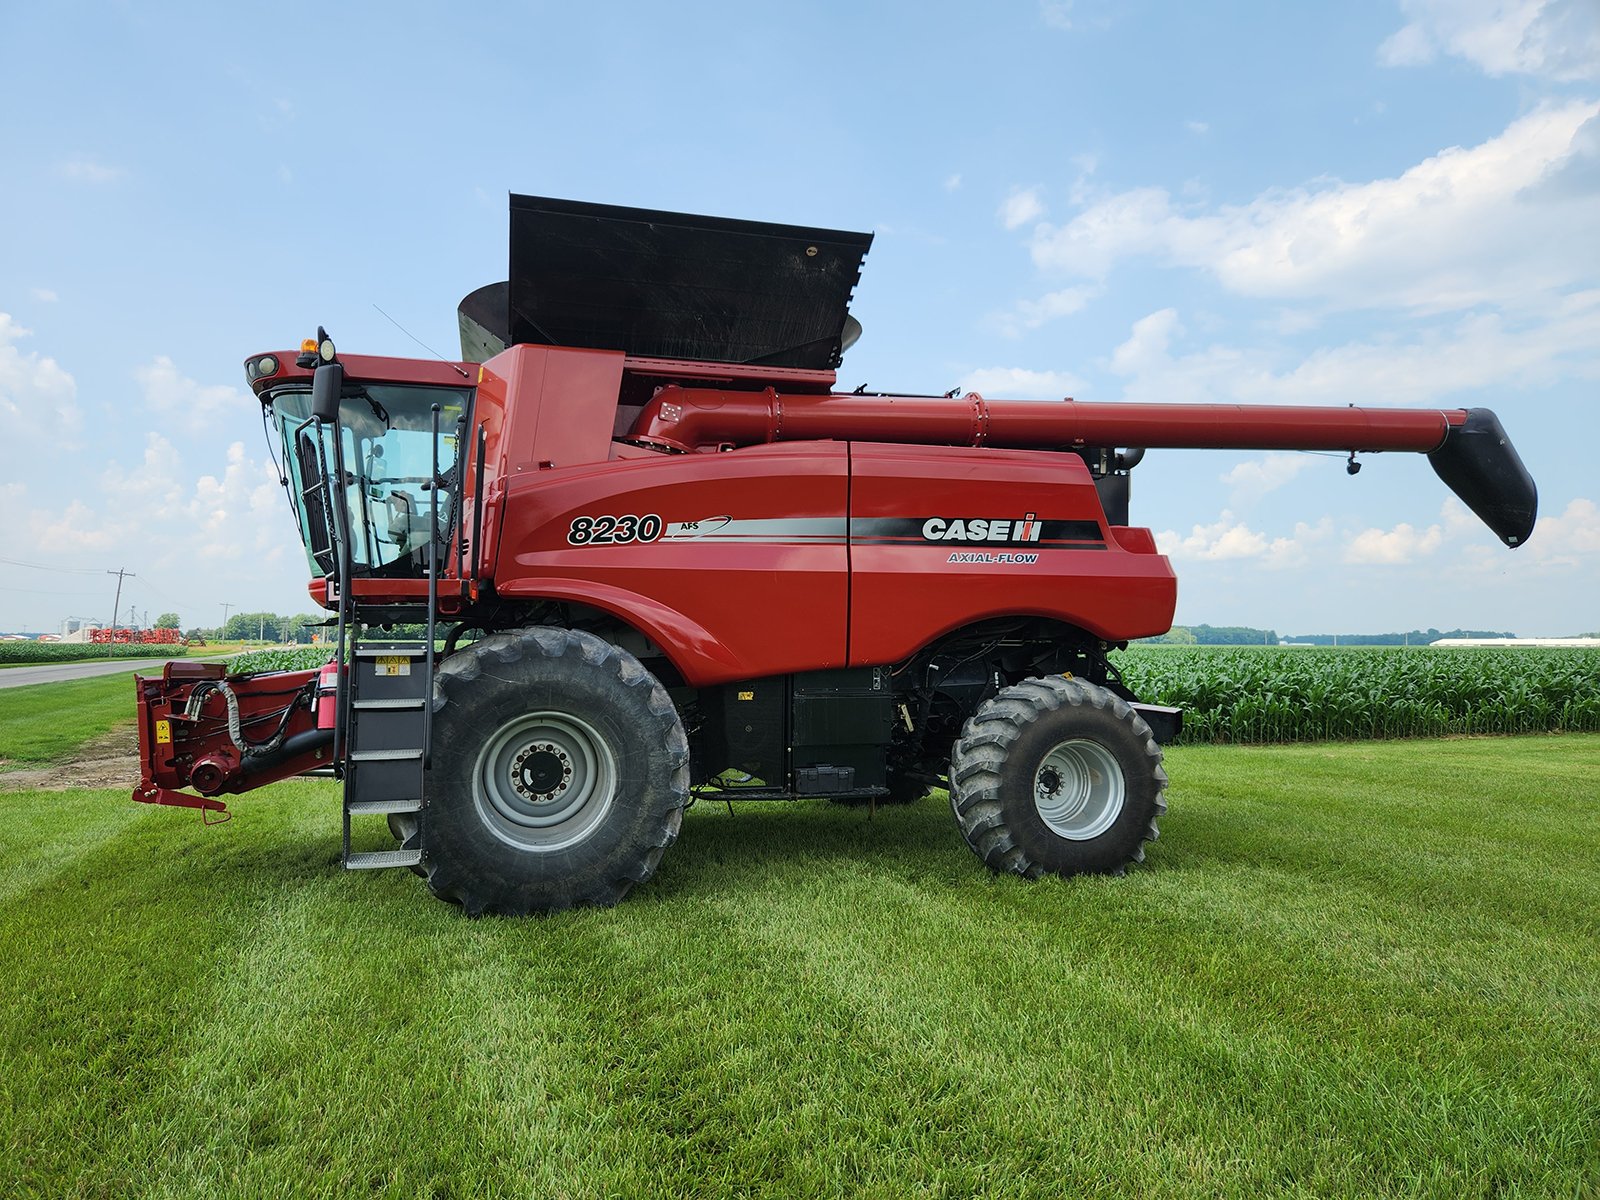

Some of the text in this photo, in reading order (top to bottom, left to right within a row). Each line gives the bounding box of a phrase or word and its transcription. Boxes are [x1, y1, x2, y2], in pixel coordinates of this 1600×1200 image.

[567, 513, 662, 546] 8230
[680, 521, 700, 531] AFS
[922, 517, 1011, 541] CASE
[947, 552, 1039, 564] AXIAL-FLOW
